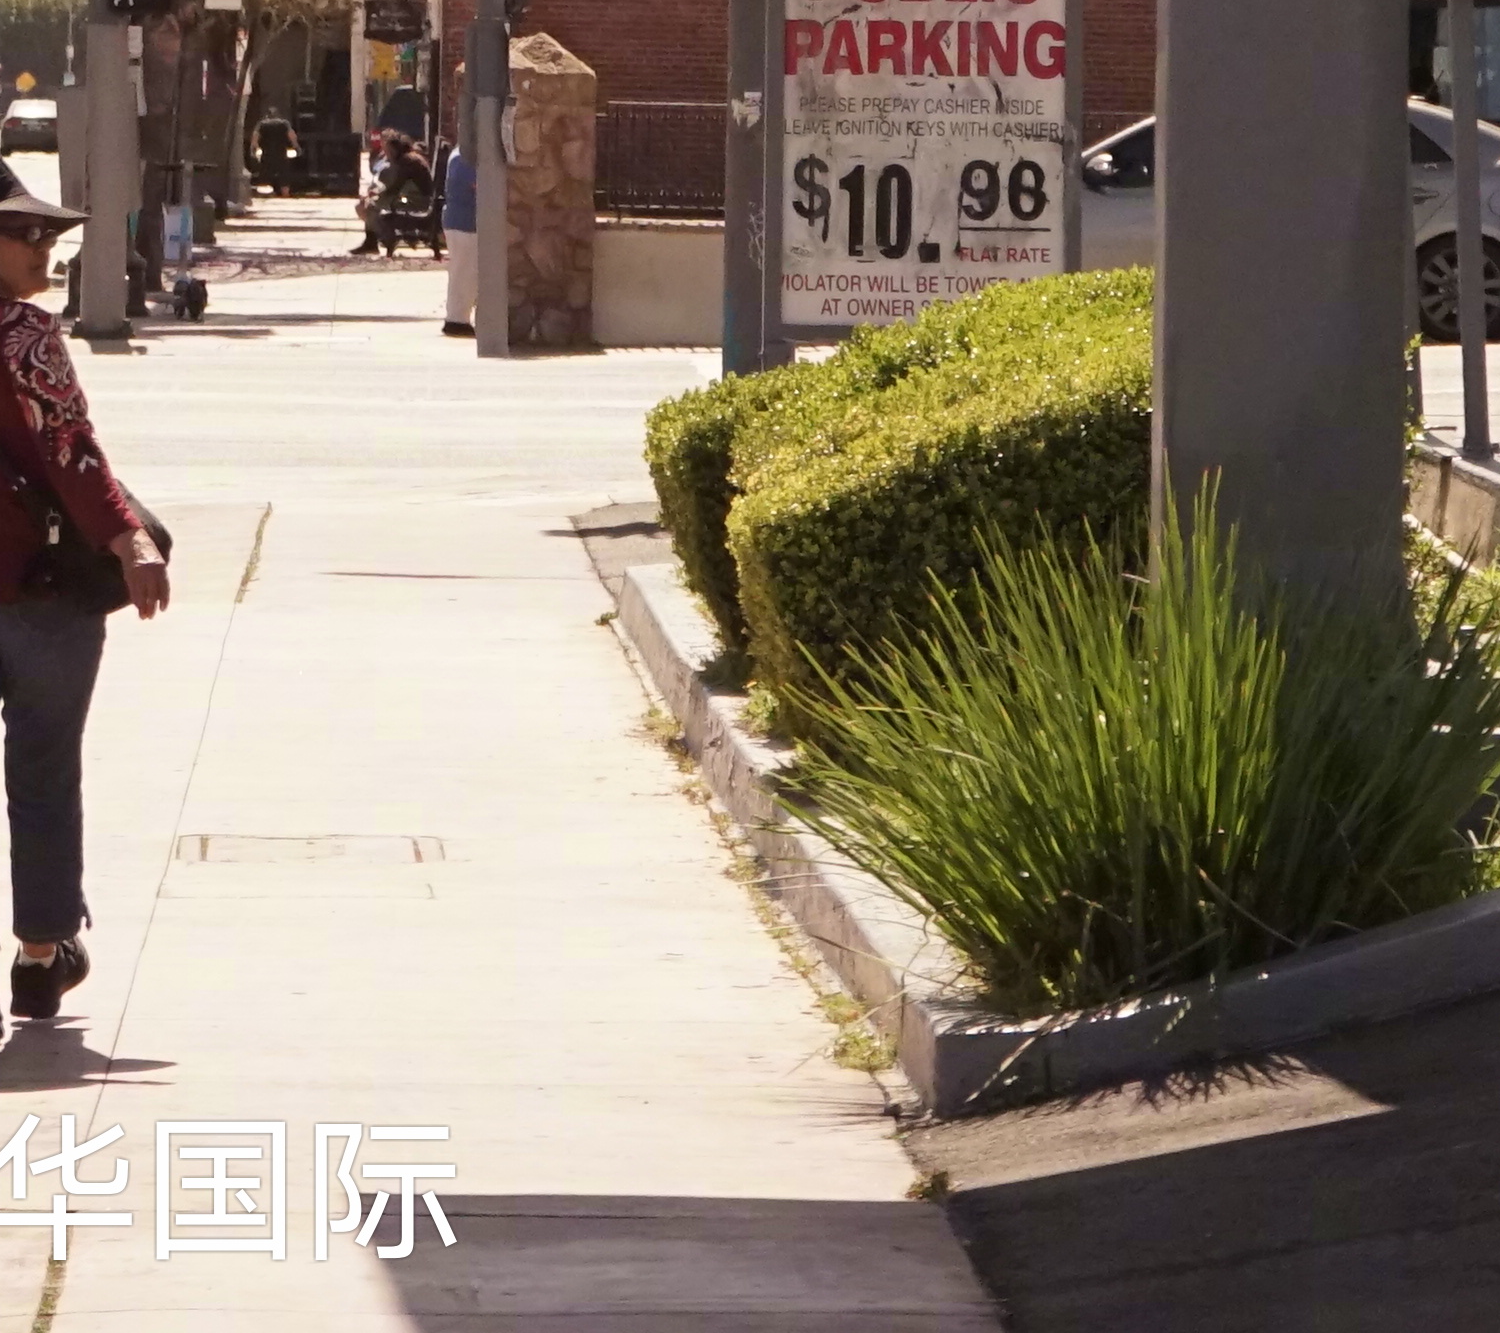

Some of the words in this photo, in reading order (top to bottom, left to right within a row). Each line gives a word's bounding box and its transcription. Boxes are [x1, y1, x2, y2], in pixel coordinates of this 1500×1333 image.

[784, 19, 1067, 80] PARKING
[799, 96, 857, 114] PLEASE
[861, 97, 920, 115] PREPAY
[923, 98, 991, 116] CASHIER
[994, 98, 1045, 116] INSIDE
[785, 118, 831, 135] LEAVE
[835, 120, 901, 137] IGNITION
[906, 121, 946, 137] KEYS
[950, 121, 989, 138] WITH
[959, 246, 999, 264] FLAT
[1006, 247, 1051, 264] RATE
[866, 276, 911, 293] WILL
[916, 276, 939, 293] BE
[945, 277, 1008, 293] TOWE
[821, 299, 843, 314] AT
[847, 299, 915, 317] OWNER
